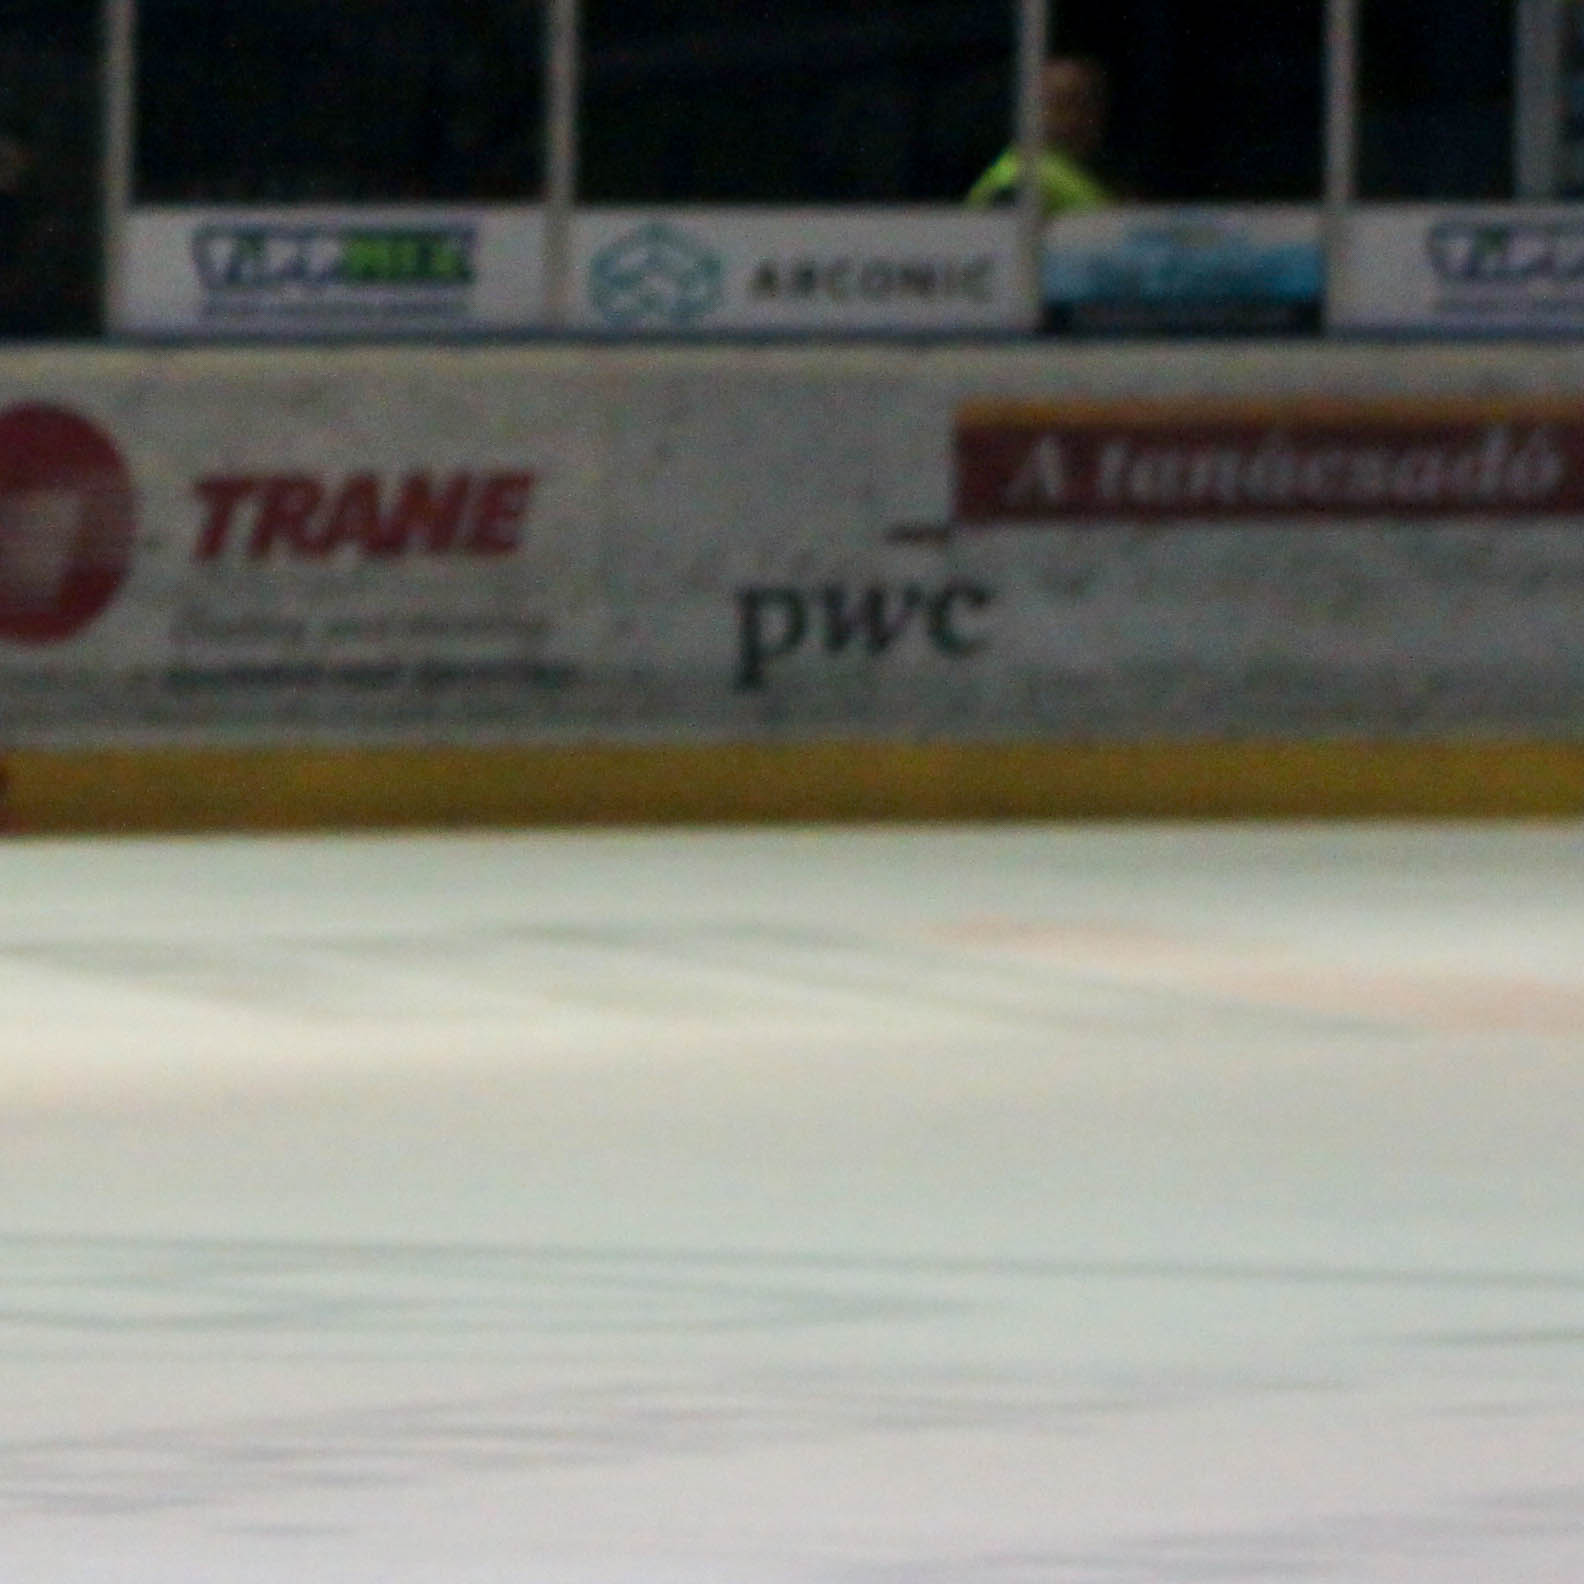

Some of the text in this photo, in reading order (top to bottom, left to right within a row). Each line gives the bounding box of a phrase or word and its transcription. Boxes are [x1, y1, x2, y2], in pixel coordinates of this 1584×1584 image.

[192, 467, 540, 562] TRANE
[1006, 432, 1068, 503] A
[734, 576, 998, 692] pwc
